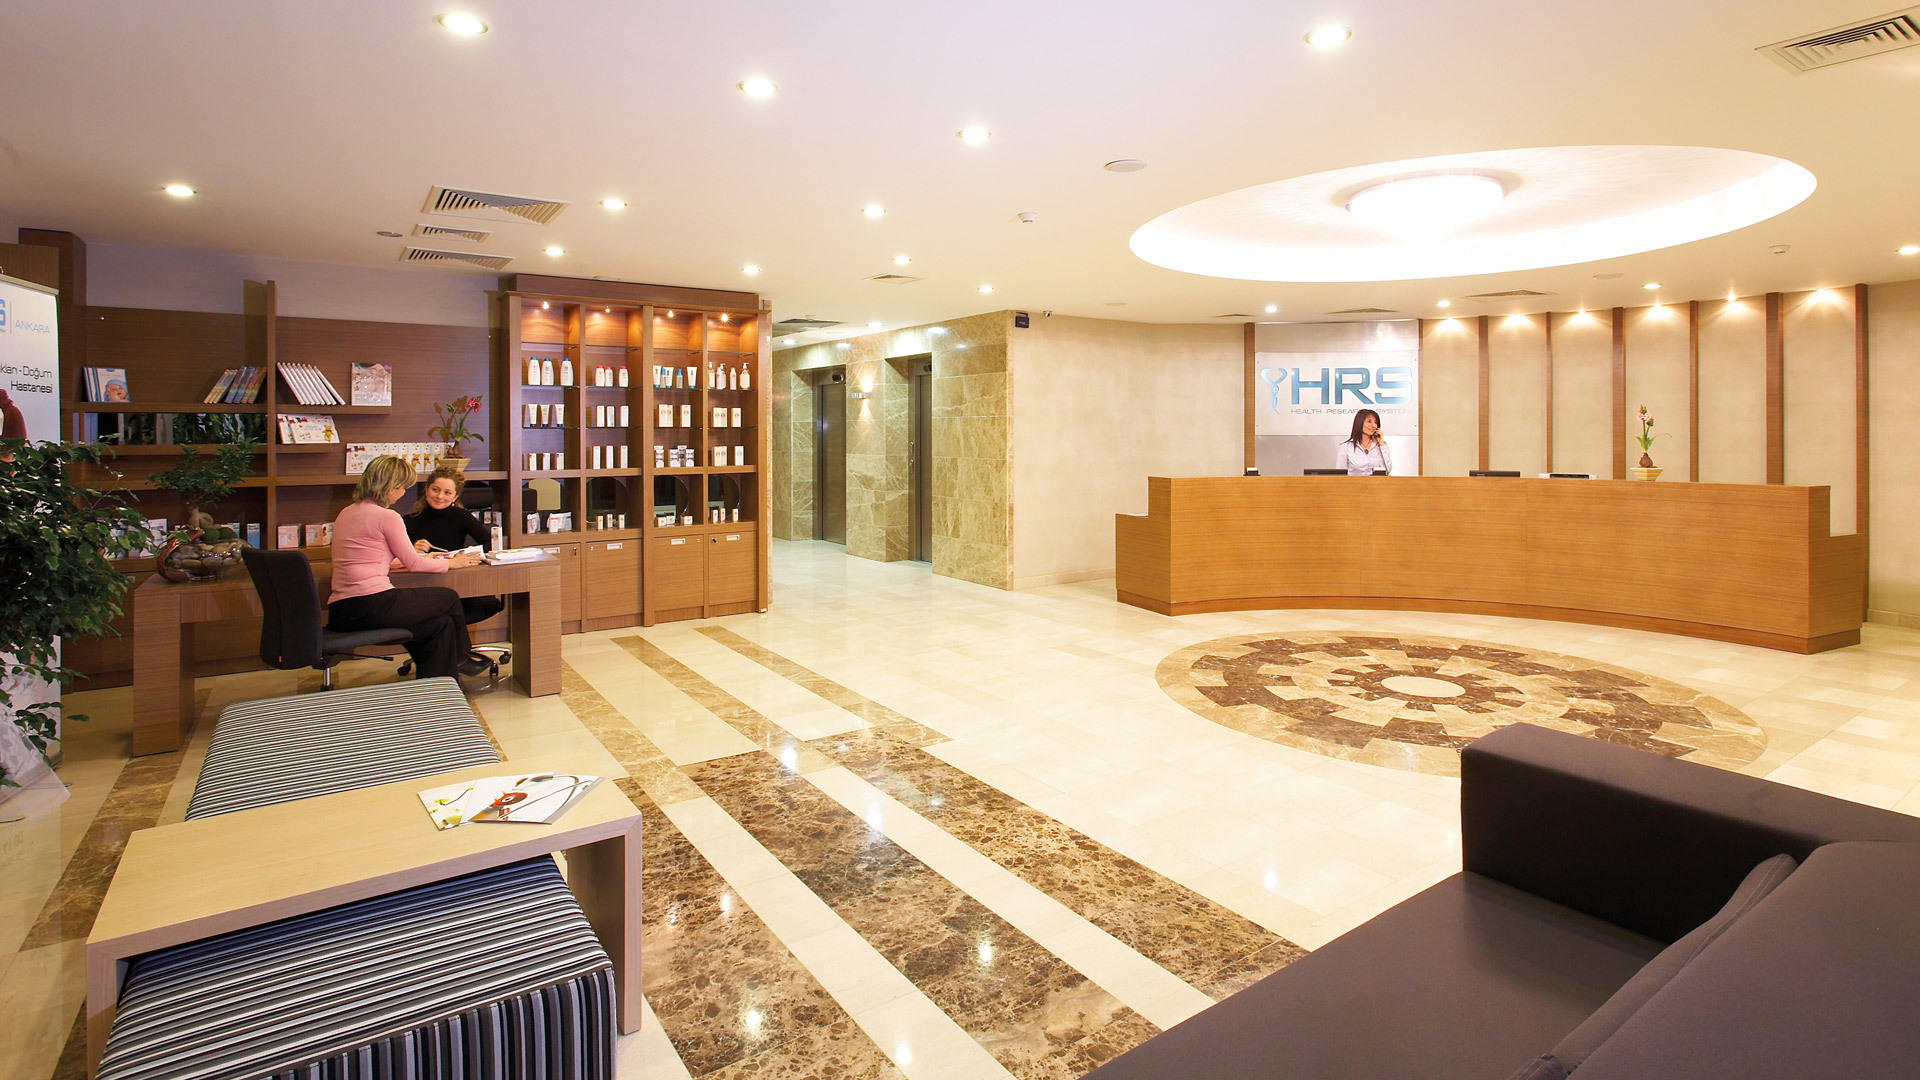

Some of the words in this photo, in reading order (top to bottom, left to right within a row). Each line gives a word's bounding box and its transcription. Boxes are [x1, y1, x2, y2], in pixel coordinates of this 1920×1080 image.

[15, 319, 51, 334] ANKARA
[10, 380, 53, 394] Hastanesi
[1291, 366, 1413, 405] HRS
